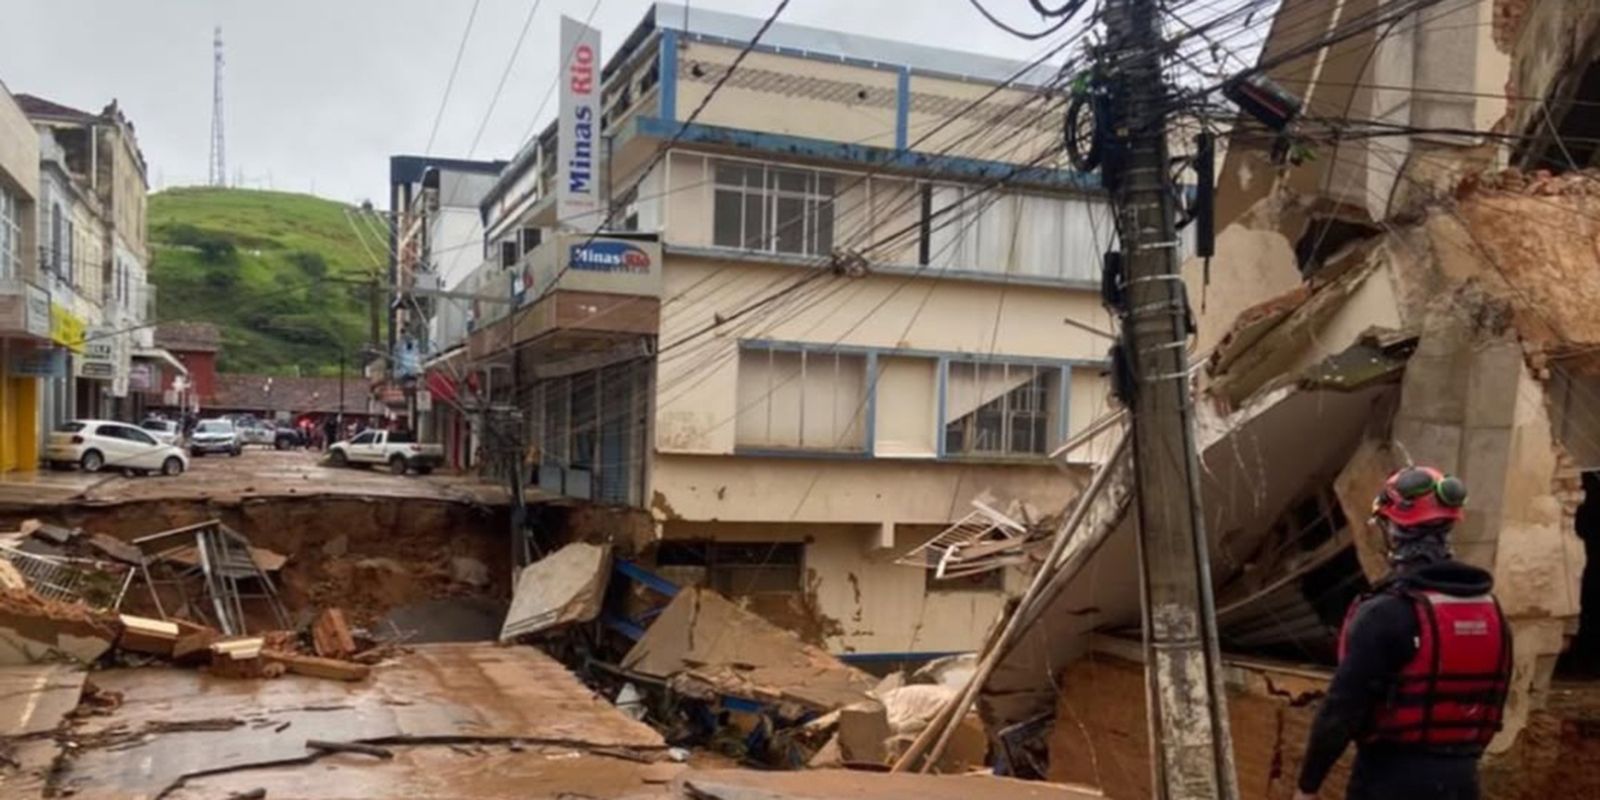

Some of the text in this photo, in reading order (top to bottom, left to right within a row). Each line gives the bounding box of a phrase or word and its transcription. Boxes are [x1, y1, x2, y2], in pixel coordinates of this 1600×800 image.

[570, 44, 593, 95] Rio
[569, 105, 592, 195] Minas
[575, 248, 621, 265] Minas
